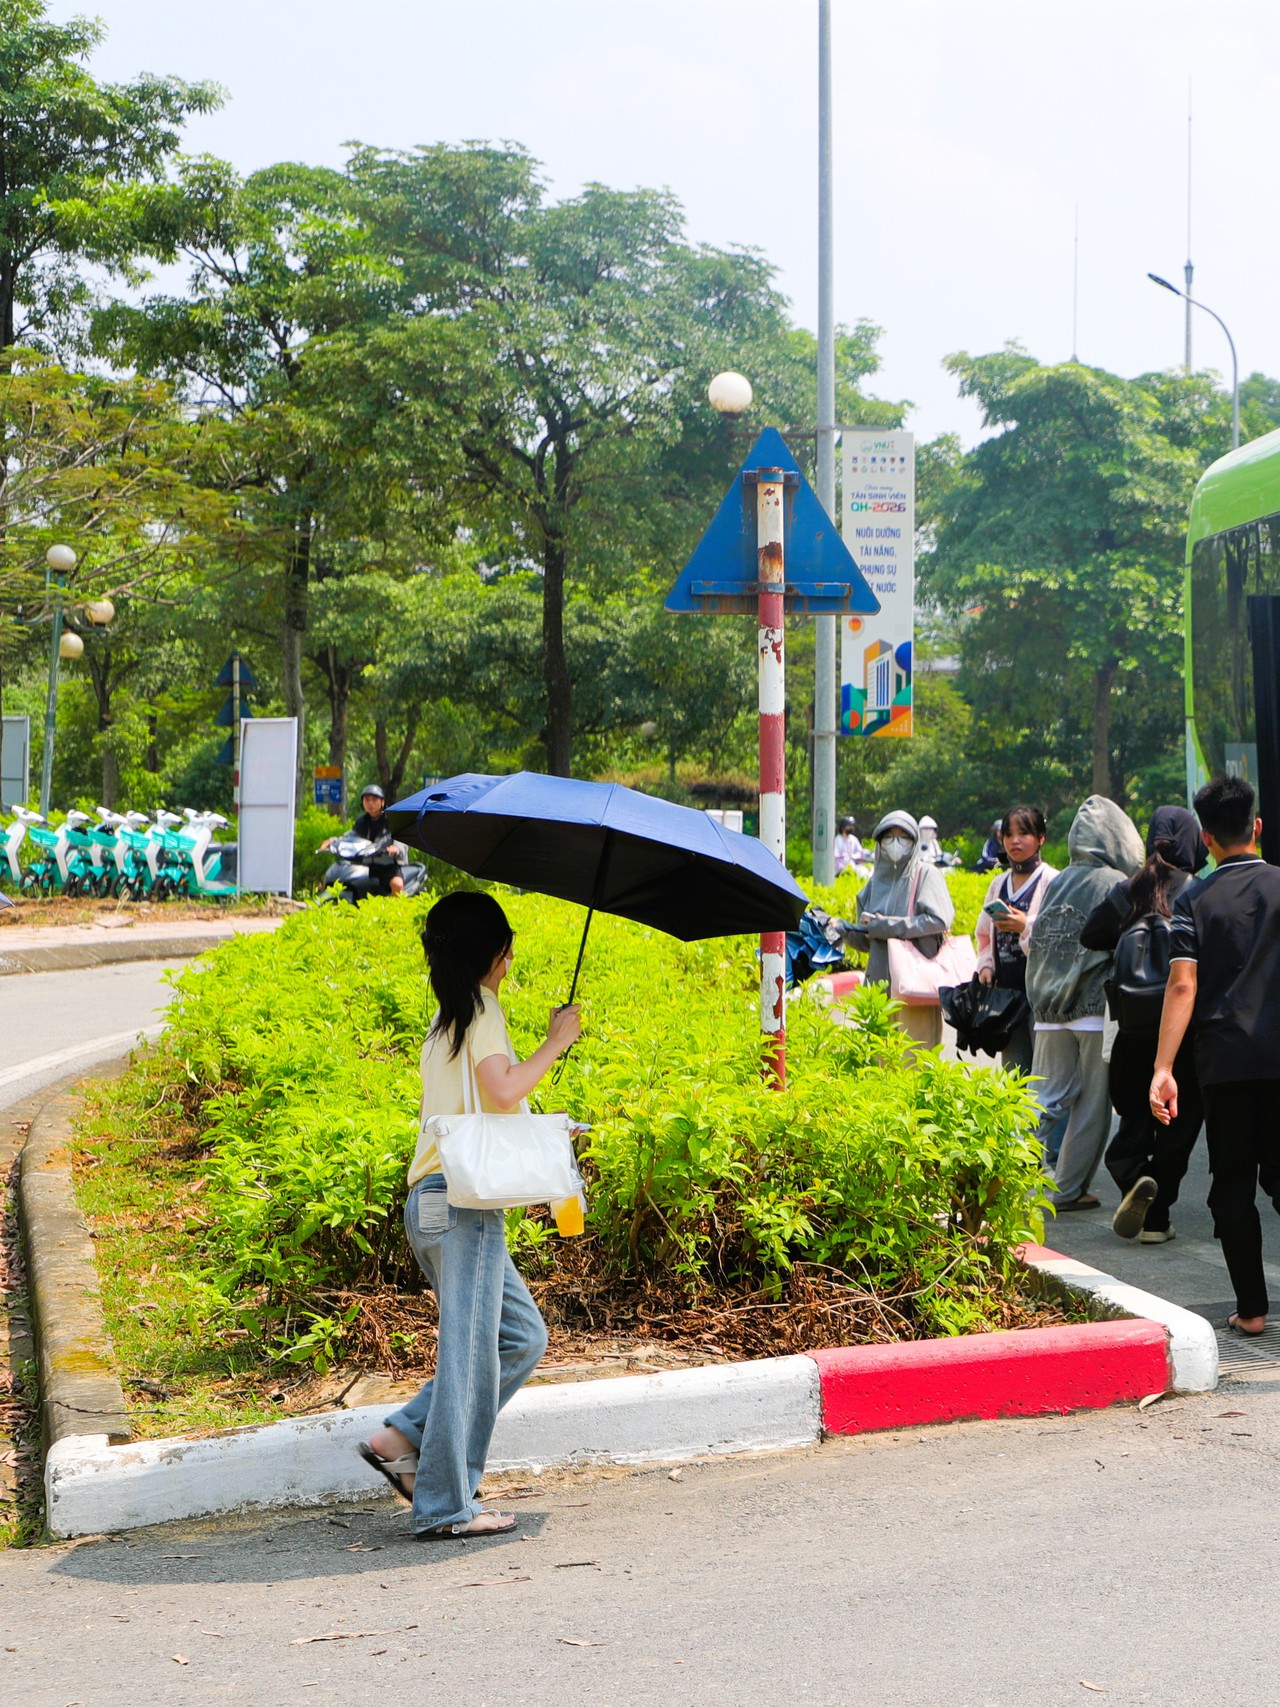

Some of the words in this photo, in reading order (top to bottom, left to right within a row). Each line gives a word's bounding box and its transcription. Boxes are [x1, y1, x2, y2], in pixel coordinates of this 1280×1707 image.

[867, 492, 887, 500] SINH
[850, 501, 906, 513] QH-2026
[855, 526, 874, 539] NUÔI
